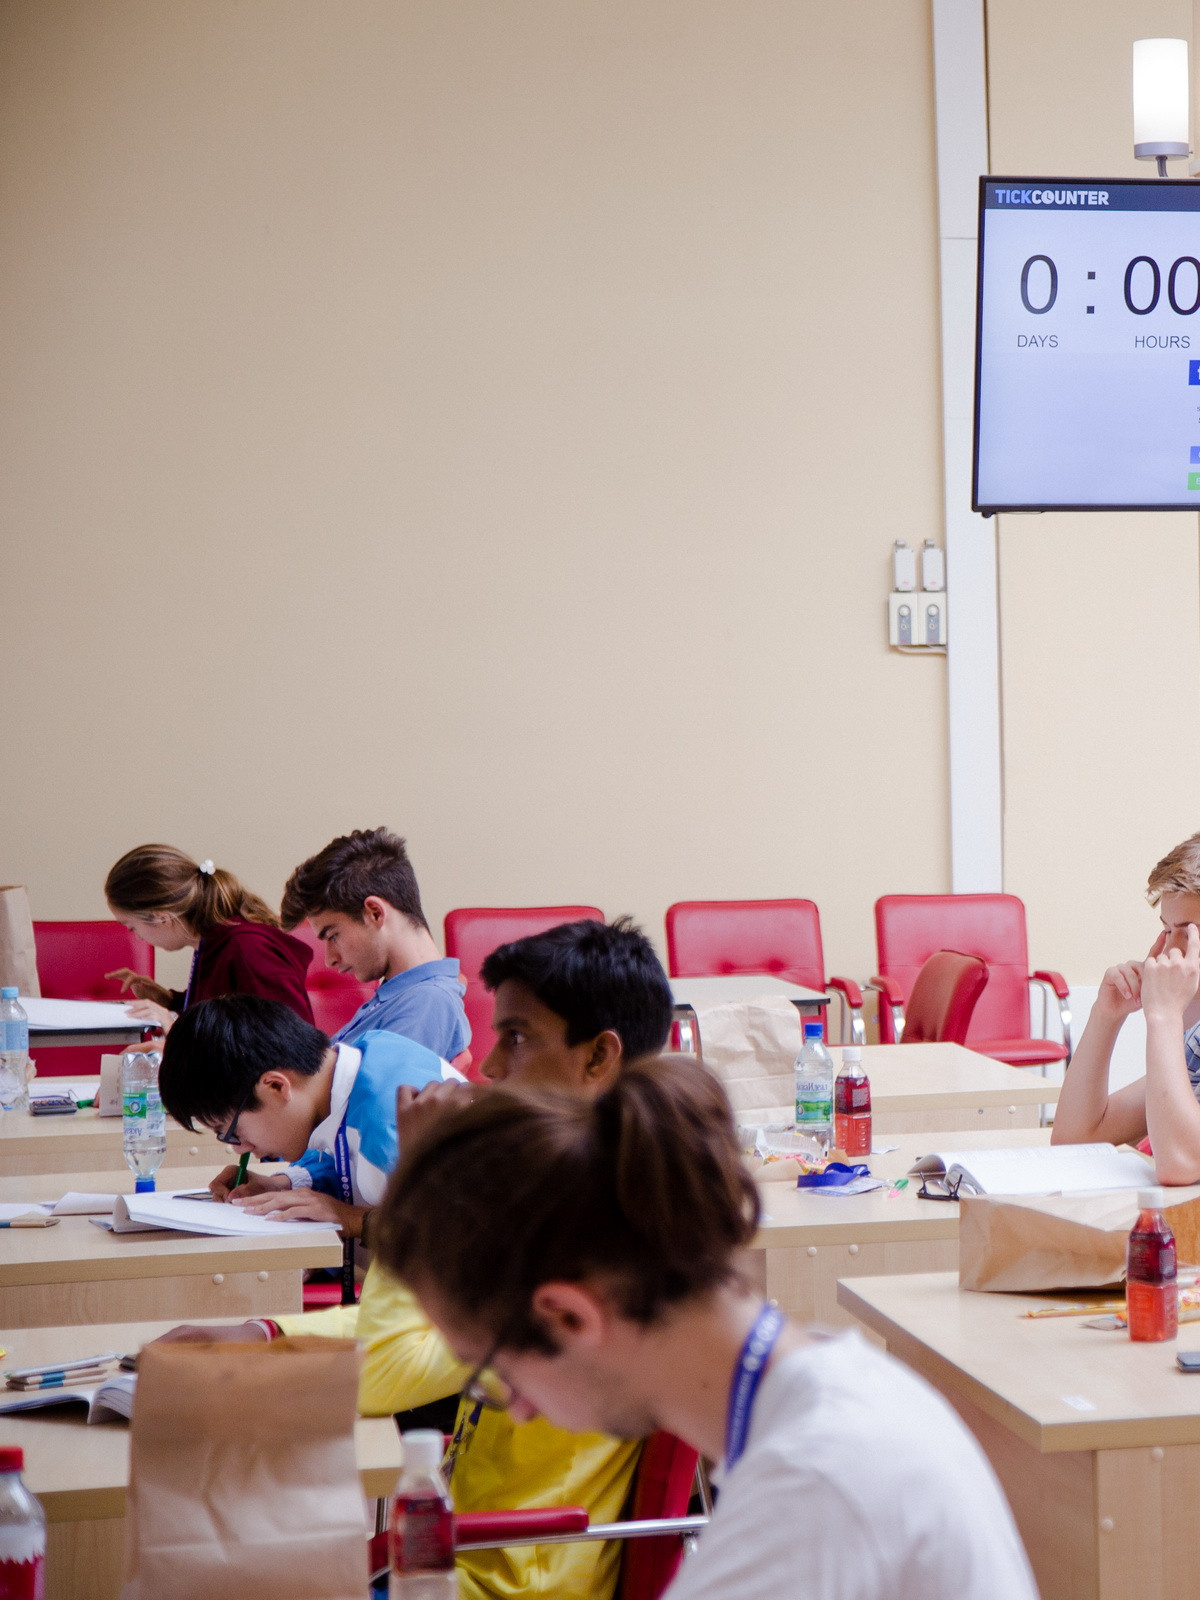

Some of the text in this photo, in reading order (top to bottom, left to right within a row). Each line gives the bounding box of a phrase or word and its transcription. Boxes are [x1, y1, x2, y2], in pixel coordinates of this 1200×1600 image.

[995, 188, 1110, 206] TICKCOUNTER
[1019, 254, 1059, 315] 0
[1016, 334, 1060, 349] DAYS
[1134, 335, 1191, 350] HOURS
